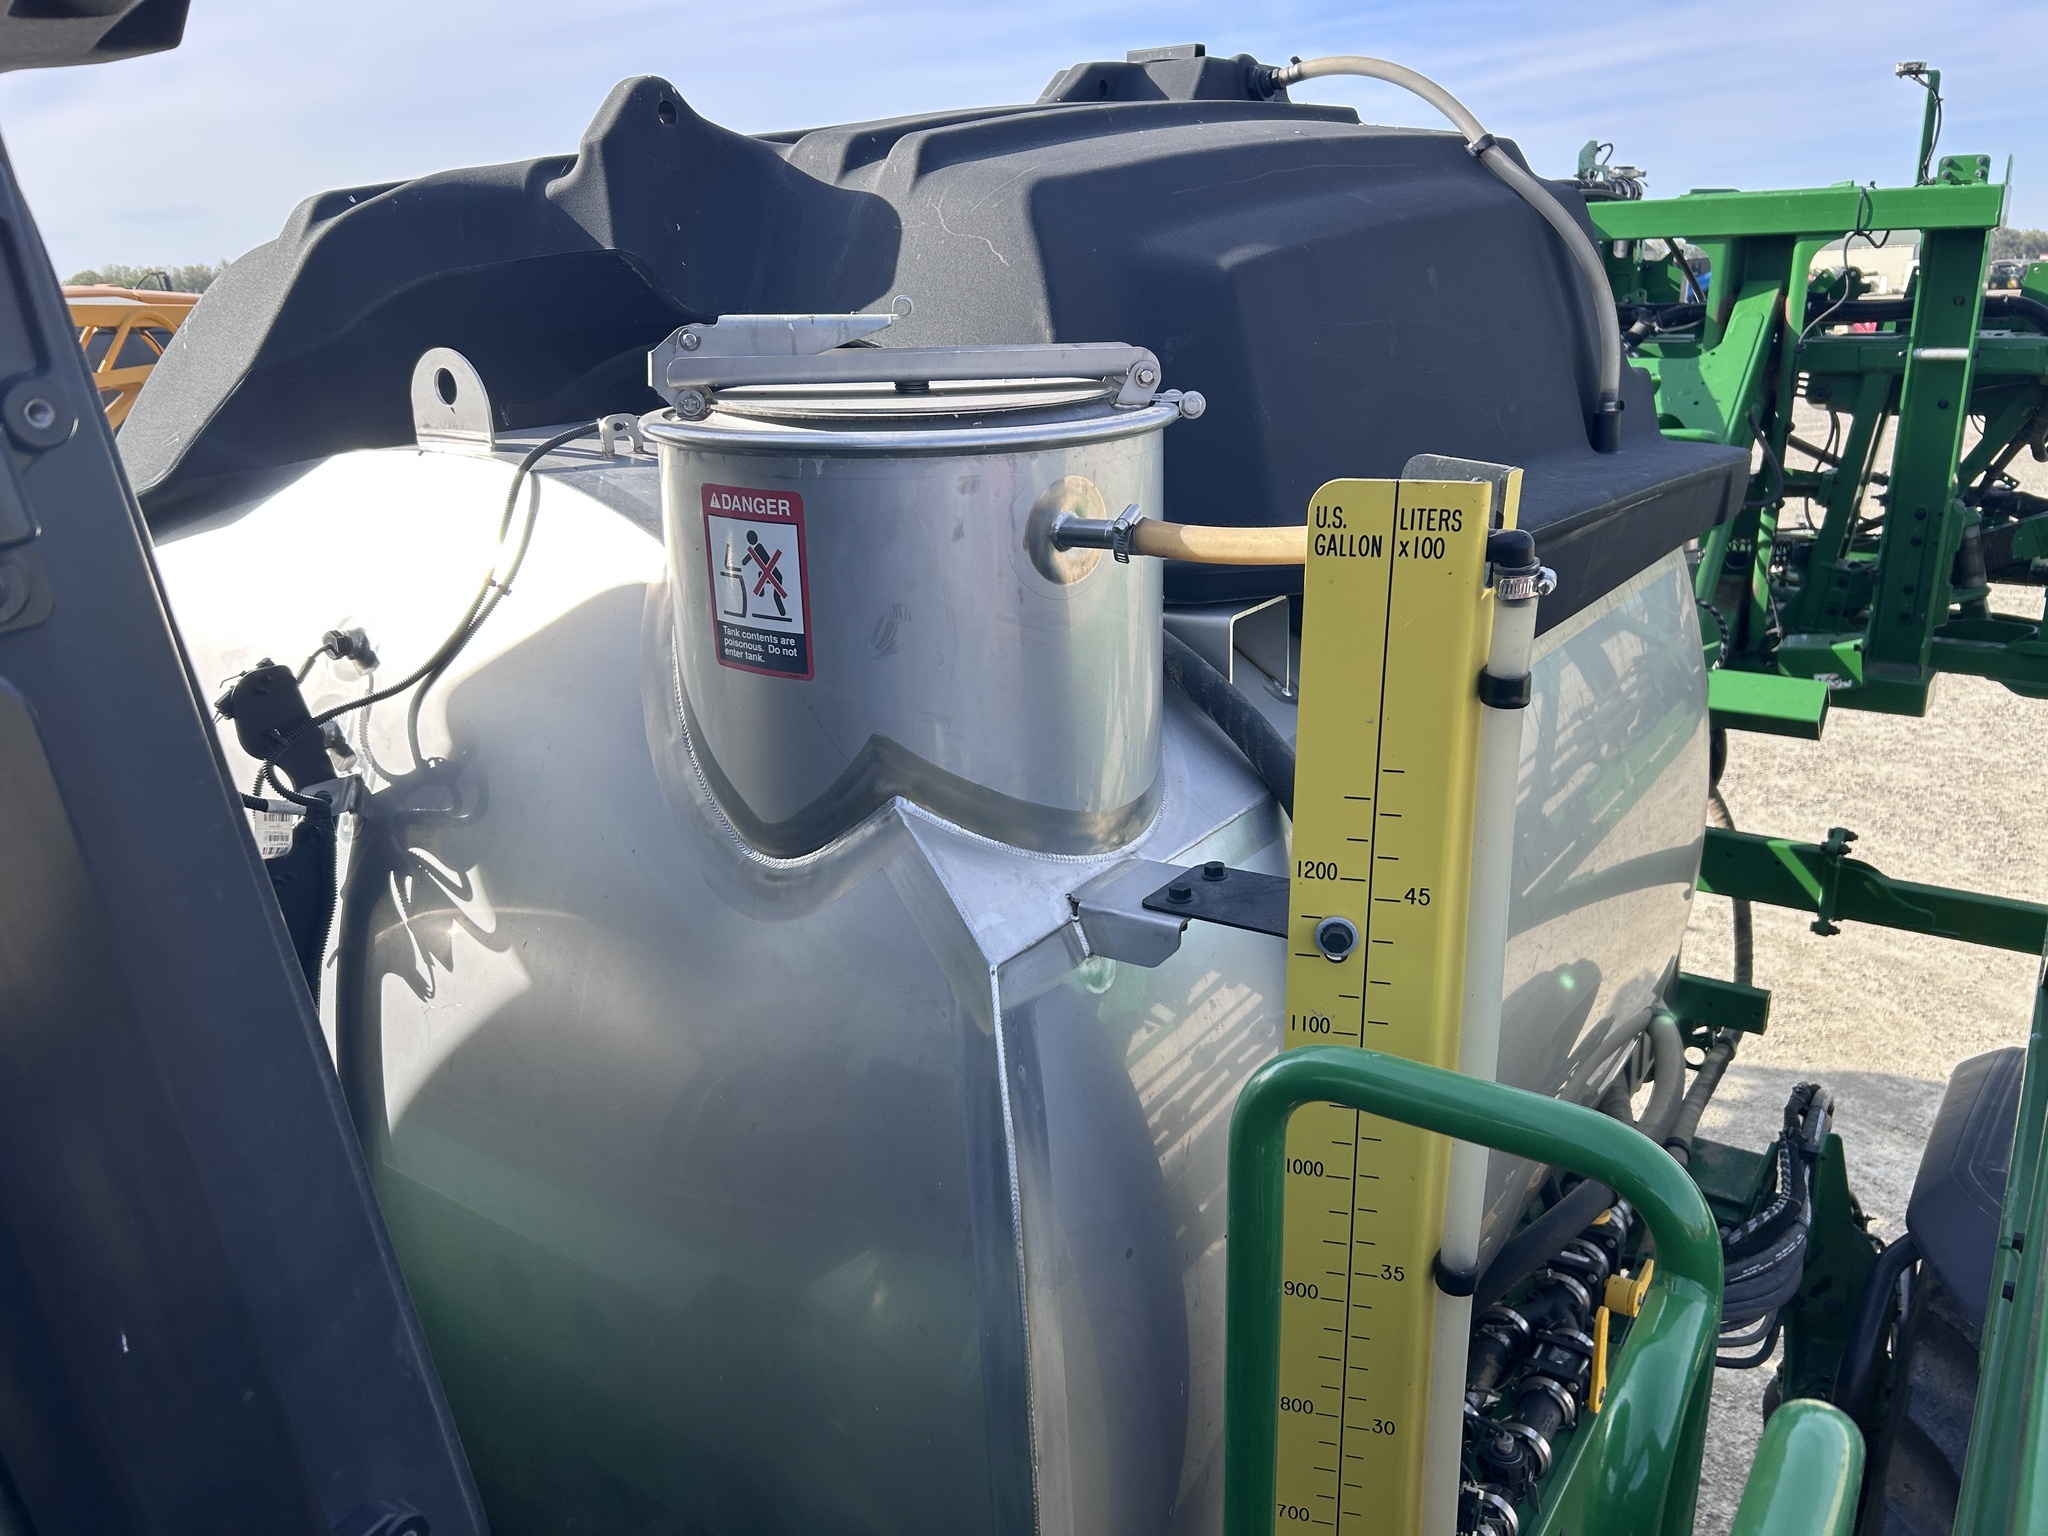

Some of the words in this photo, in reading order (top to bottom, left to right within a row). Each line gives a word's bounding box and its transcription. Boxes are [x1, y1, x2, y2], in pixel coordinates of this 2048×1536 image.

[721, 493, 791, 516] DANGER
[1315, 506, 1347, 529] U.S.
[1400, 508, 1463, 532] LITERS
[1314, 534, 1382, 558] GALLON
[722, 625, 740, 638] Tank
[742, 629, 778, 644] contents
[780, 635, 796, 646] are
[724, 637, 765, 653] poisonous.
[768, 644, 782, 655] Do
[782, 646, 798, 657] not
[724, 648, 743, 659] enter
[745, 651, 766, 663] tank.
[1297, 860, 1338, 881] 1200
[1404, 887, 1431, 906] 45
[1292, 1014, 1330, 1034] 1100
[1286, 1157, 1324, 1178] 1000
[1380, 1264, 1405, 1282] 35
[1284, 1280, 1319, 1300] 900
[1280, 1396, 1314, 1415] 800
[1372, 1418, 1396, 1436] 30
[1277, 1503, 1310, 1522] 700
